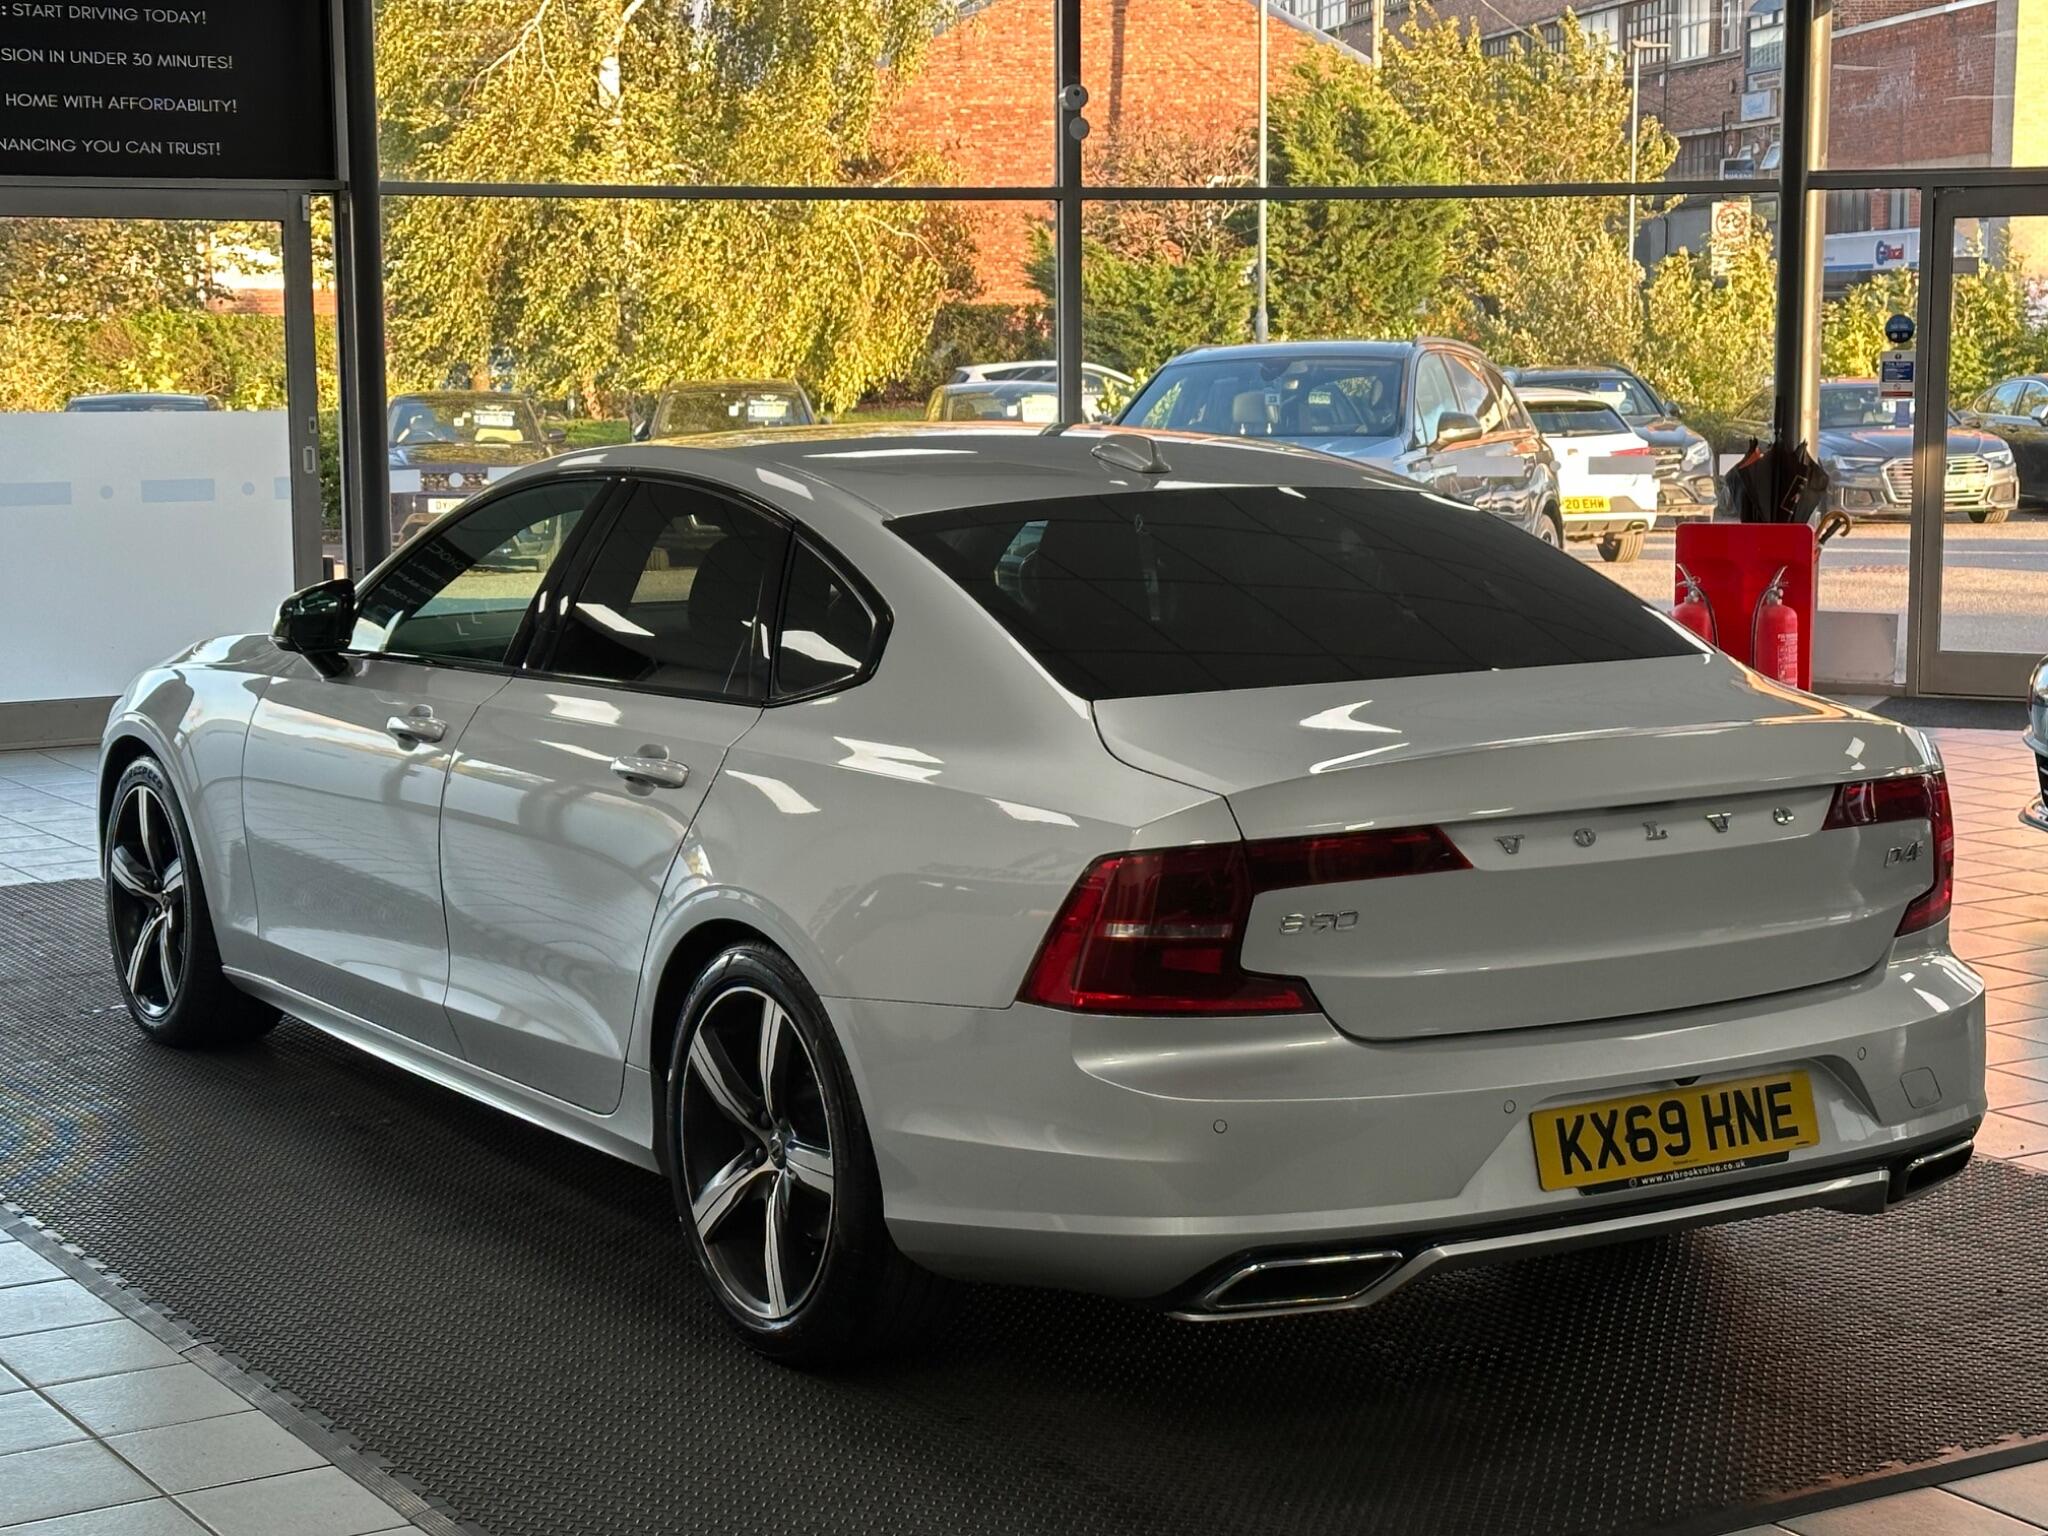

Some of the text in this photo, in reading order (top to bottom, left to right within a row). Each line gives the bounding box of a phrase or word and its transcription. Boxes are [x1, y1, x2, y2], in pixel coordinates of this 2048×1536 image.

[12, 3, 63, 18] START
[68, 5, 138, 21] DRIVING
[143, 8, 206, 24] TODAY!
[0, 48, 233, 69] SION IN UNDER 30 MINUTES!
[5, 93, 237, 113] HOME WITH AFFORDABILITY!
[81, 140, 120, 153] YOU
[125, 141, 162, 154] CAN
[166, 142, 221, 156] TRUST!
[1495, 806, 1795, 856] VOLVO
[1555, 1081, 1799, 1177] KX69 HNE
